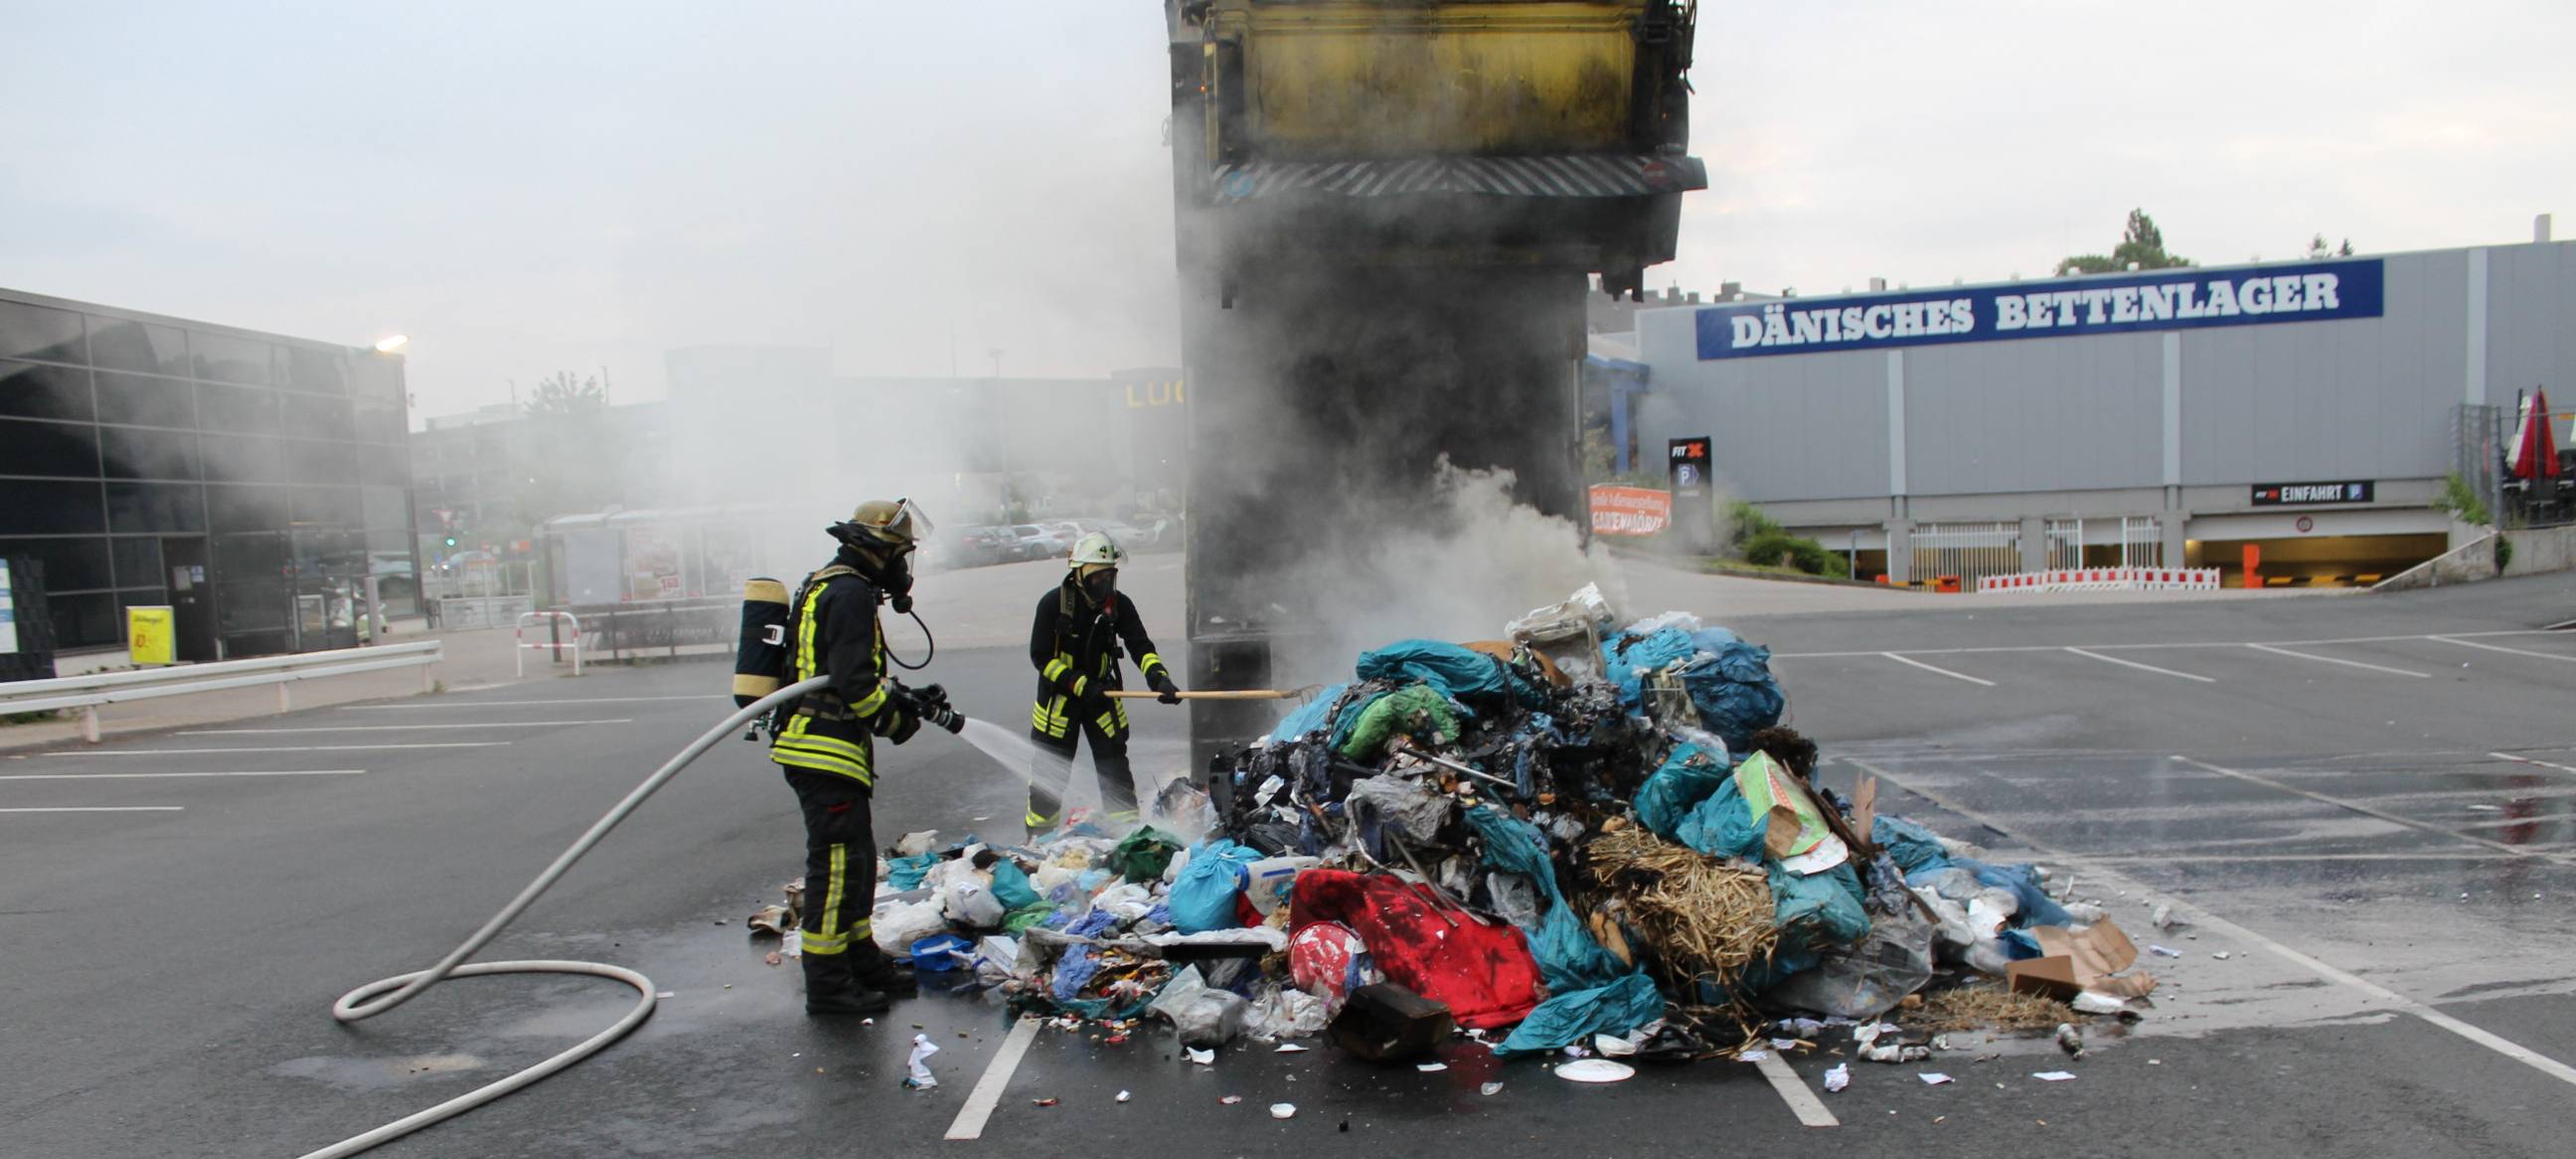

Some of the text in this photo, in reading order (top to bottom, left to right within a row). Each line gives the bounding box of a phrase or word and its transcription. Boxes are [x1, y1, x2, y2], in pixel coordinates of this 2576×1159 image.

[1730, 272, 2339, 348] DÄNISCHES BETTENLAGER
[2281, 485, 2342, 502] EINFAHRT
